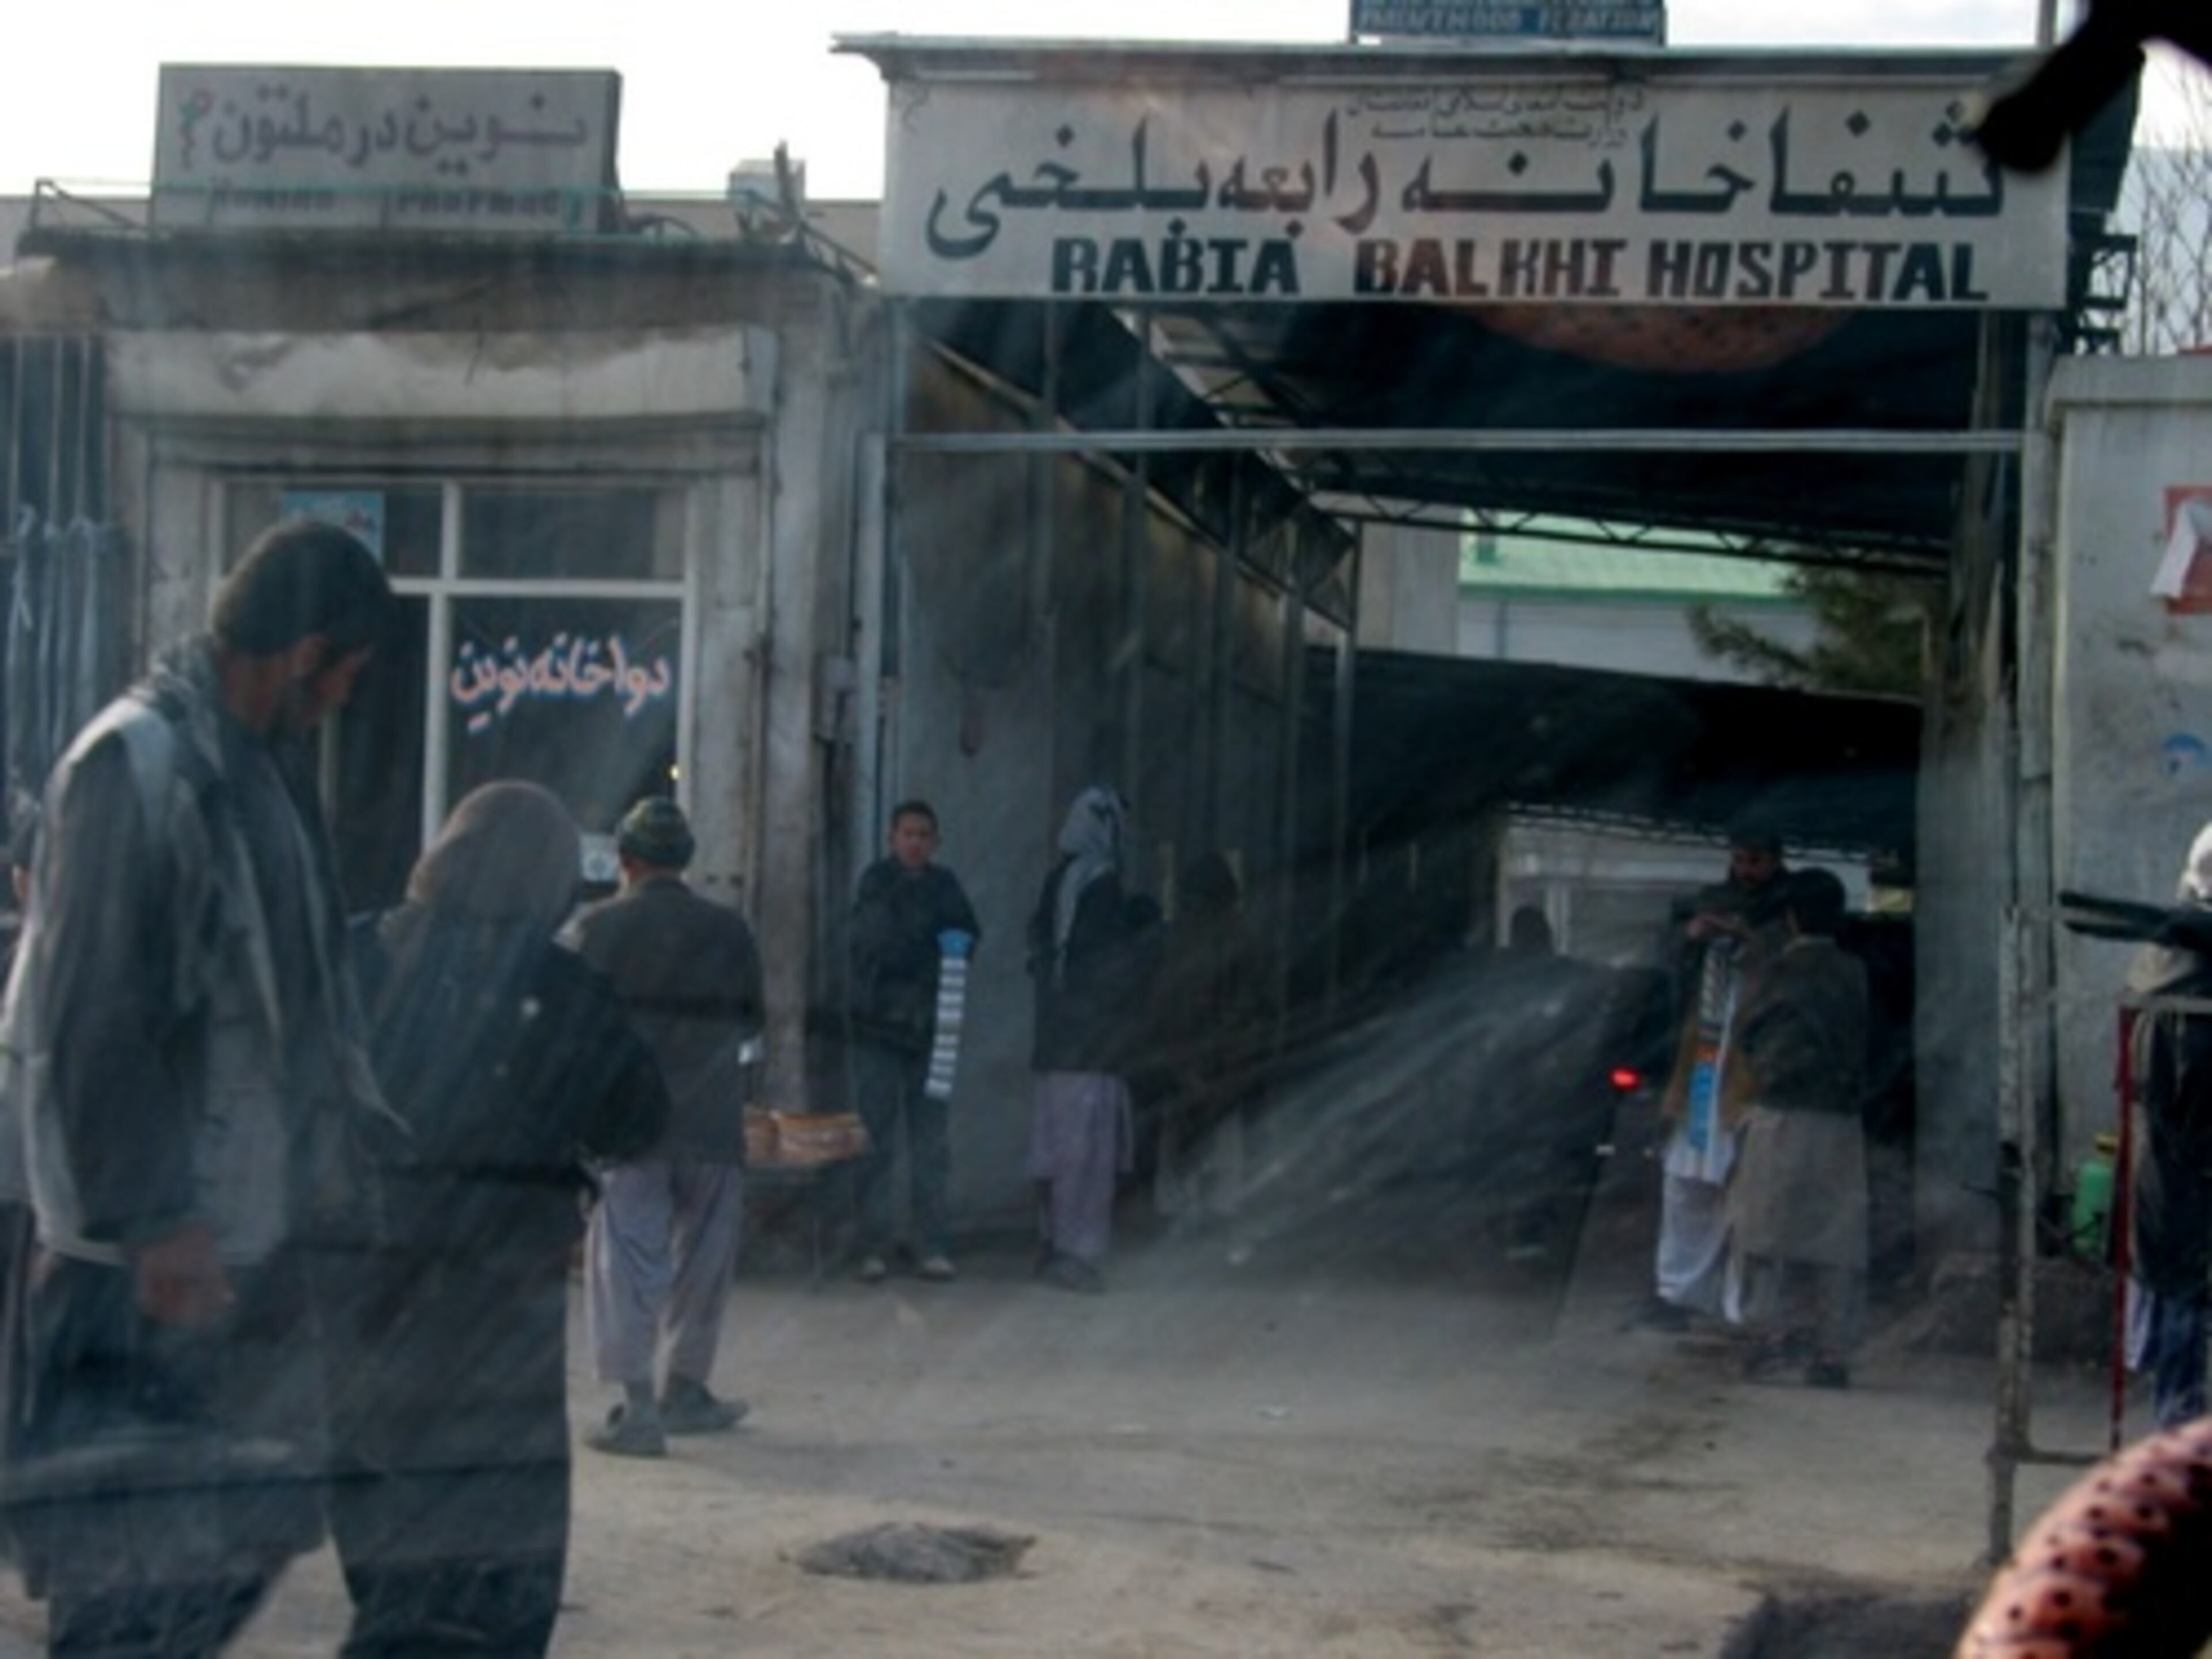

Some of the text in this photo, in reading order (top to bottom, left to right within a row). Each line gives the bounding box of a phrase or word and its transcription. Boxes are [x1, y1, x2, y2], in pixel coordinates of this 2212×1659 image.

[1052, 238, 1989, 301] RABIA BALKHI HOSPITAL
